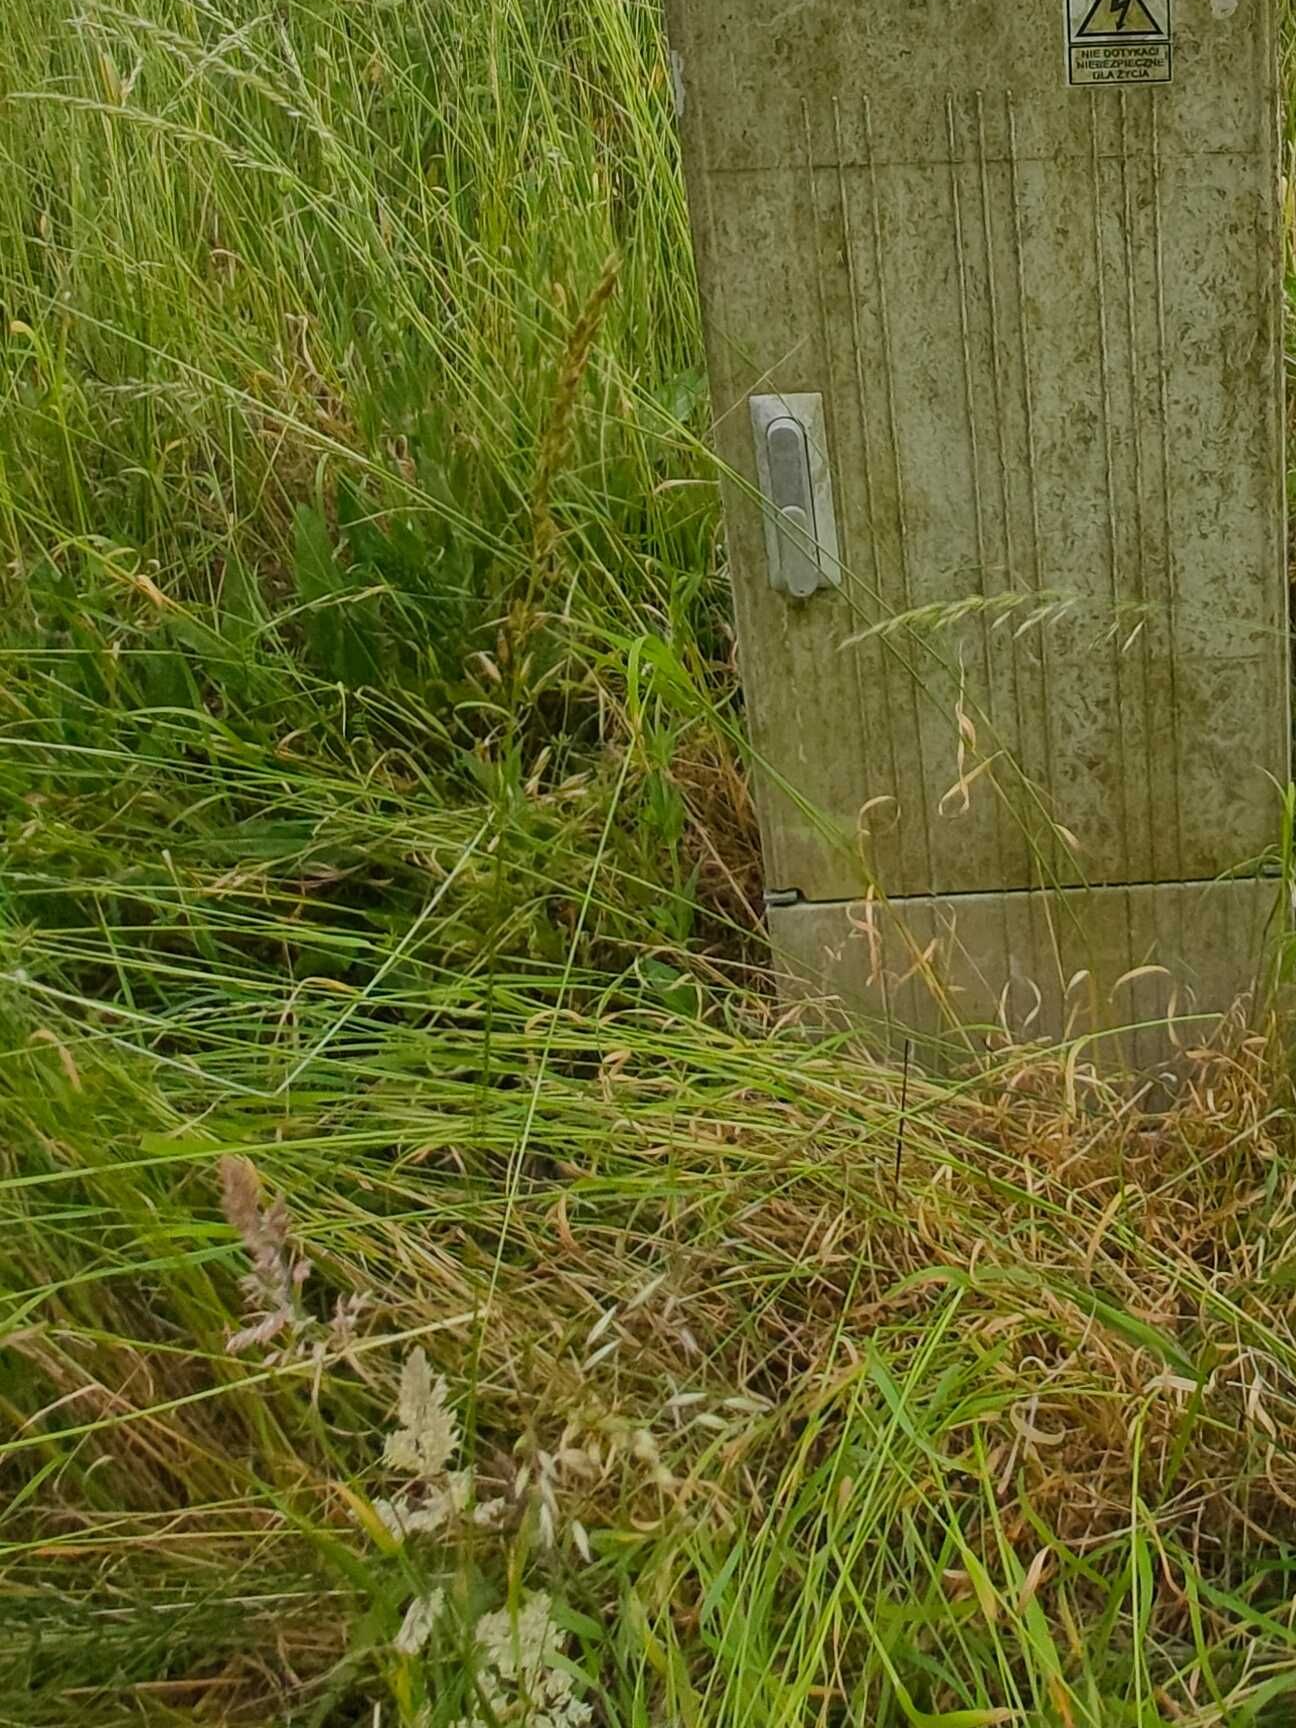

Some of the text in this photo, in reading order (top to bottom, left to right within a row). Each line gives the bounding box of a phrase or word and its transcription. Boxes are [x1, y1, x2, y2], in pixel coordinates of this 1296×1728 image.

[1081, 49, 1101, 58] NIE
[1076, 58, 1165, 69] NIEBEZPIECZNE
[1092, 70, 1115, 80] DLA
